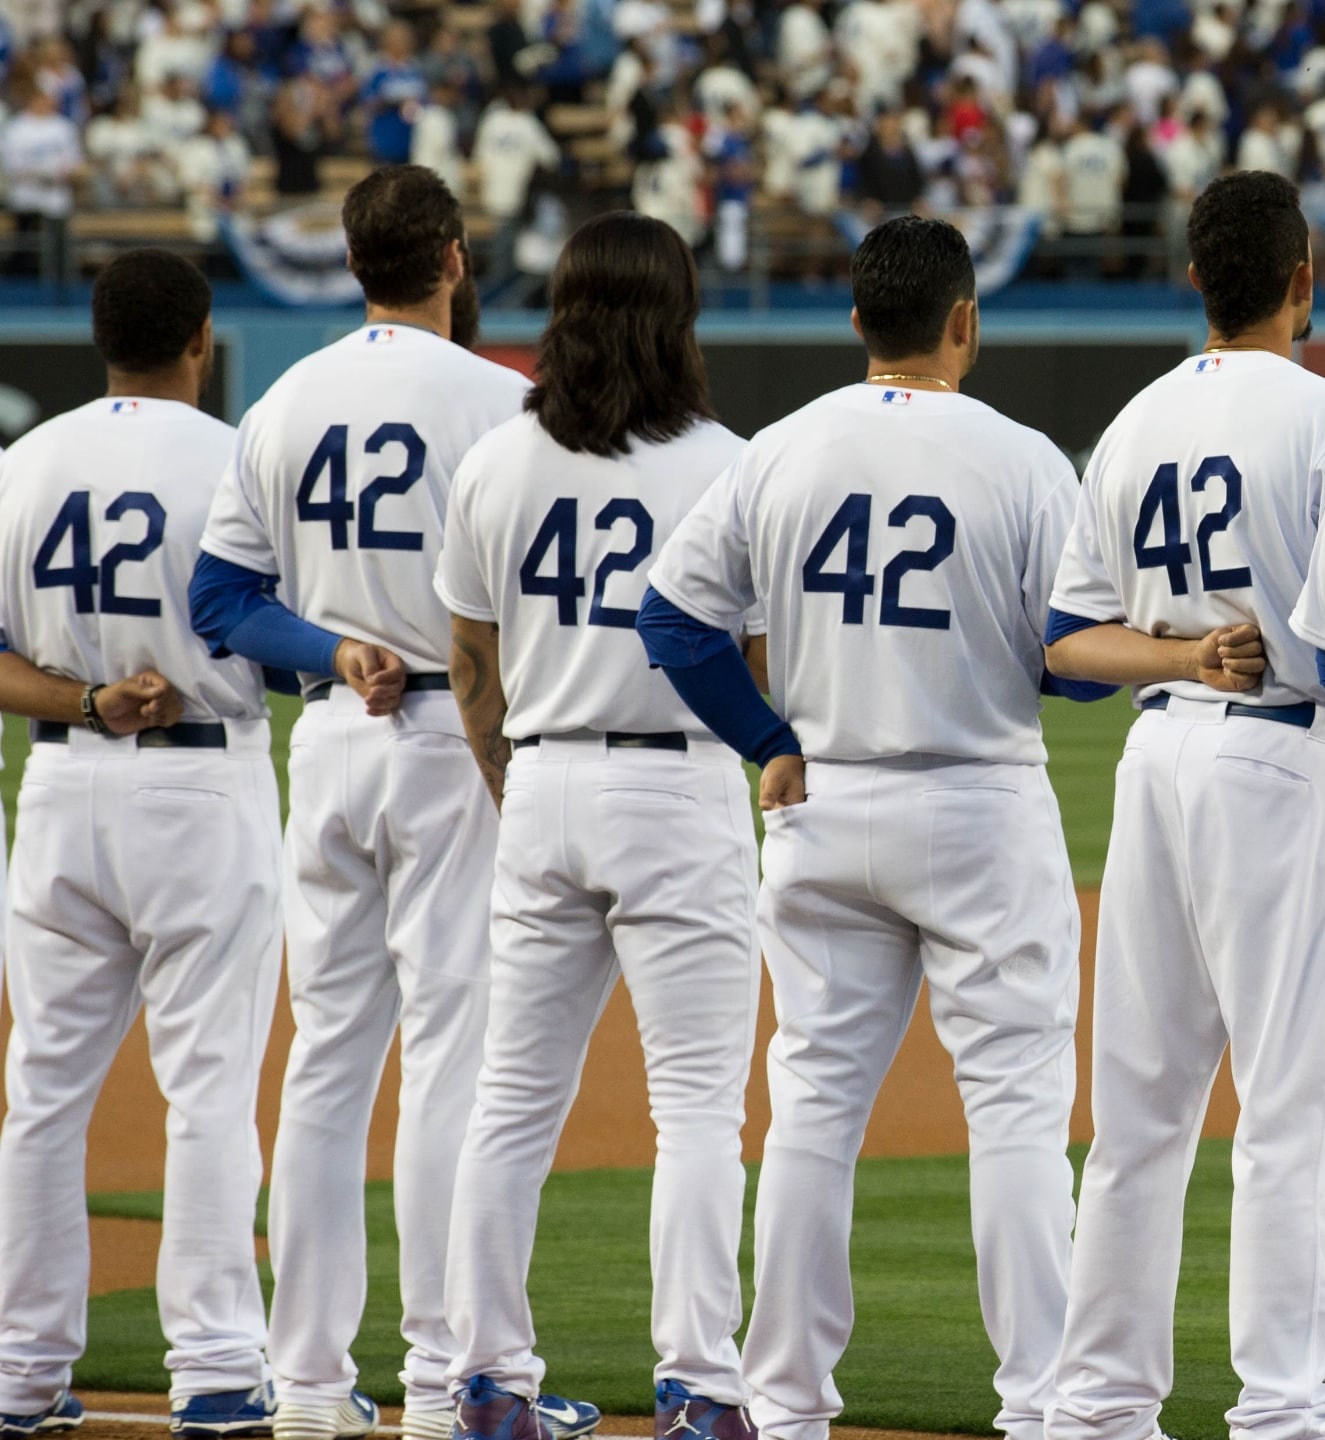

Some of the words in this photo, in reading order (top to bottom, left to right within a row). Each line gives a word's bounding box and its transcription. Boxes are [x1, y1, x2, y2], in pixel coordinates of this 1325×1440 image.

[297, 422, 427, 551] 42
[1134, 455, 1252, 595] 42
[34, 491, 167, 616] 42
[521, 497, 656, 627] 42
[803, 493, 956, 630] 42
